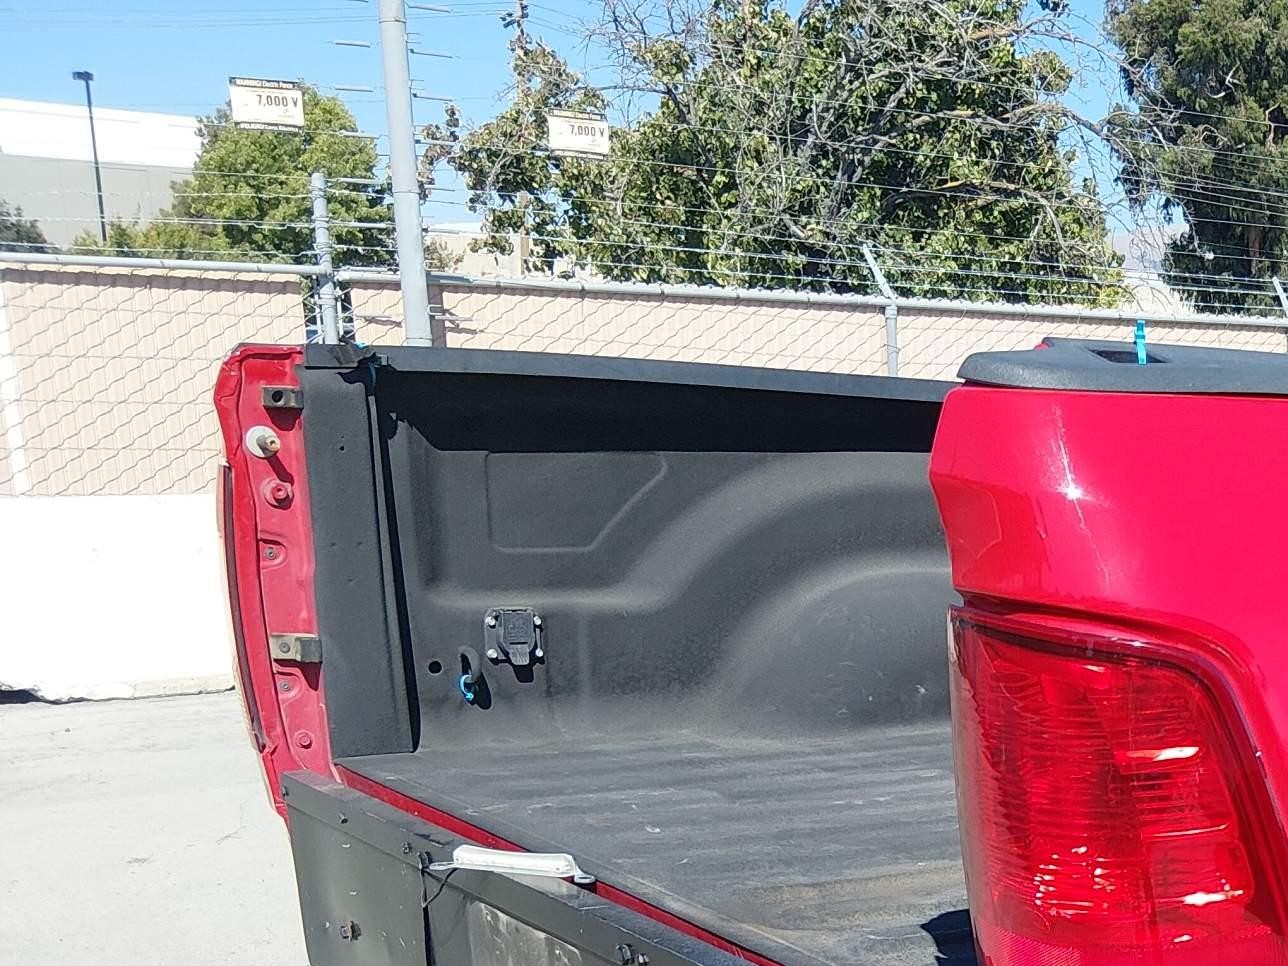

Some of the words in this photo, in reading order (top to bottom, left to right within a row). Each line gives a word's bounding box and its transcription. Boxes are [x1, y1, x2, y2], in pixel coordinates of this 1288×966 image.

[256, 94, 288, 107] 7,000
[291, 97, 298, 108] V
[569, 124, 596, 137] 7,000
[599, 127, 605, 137] V
